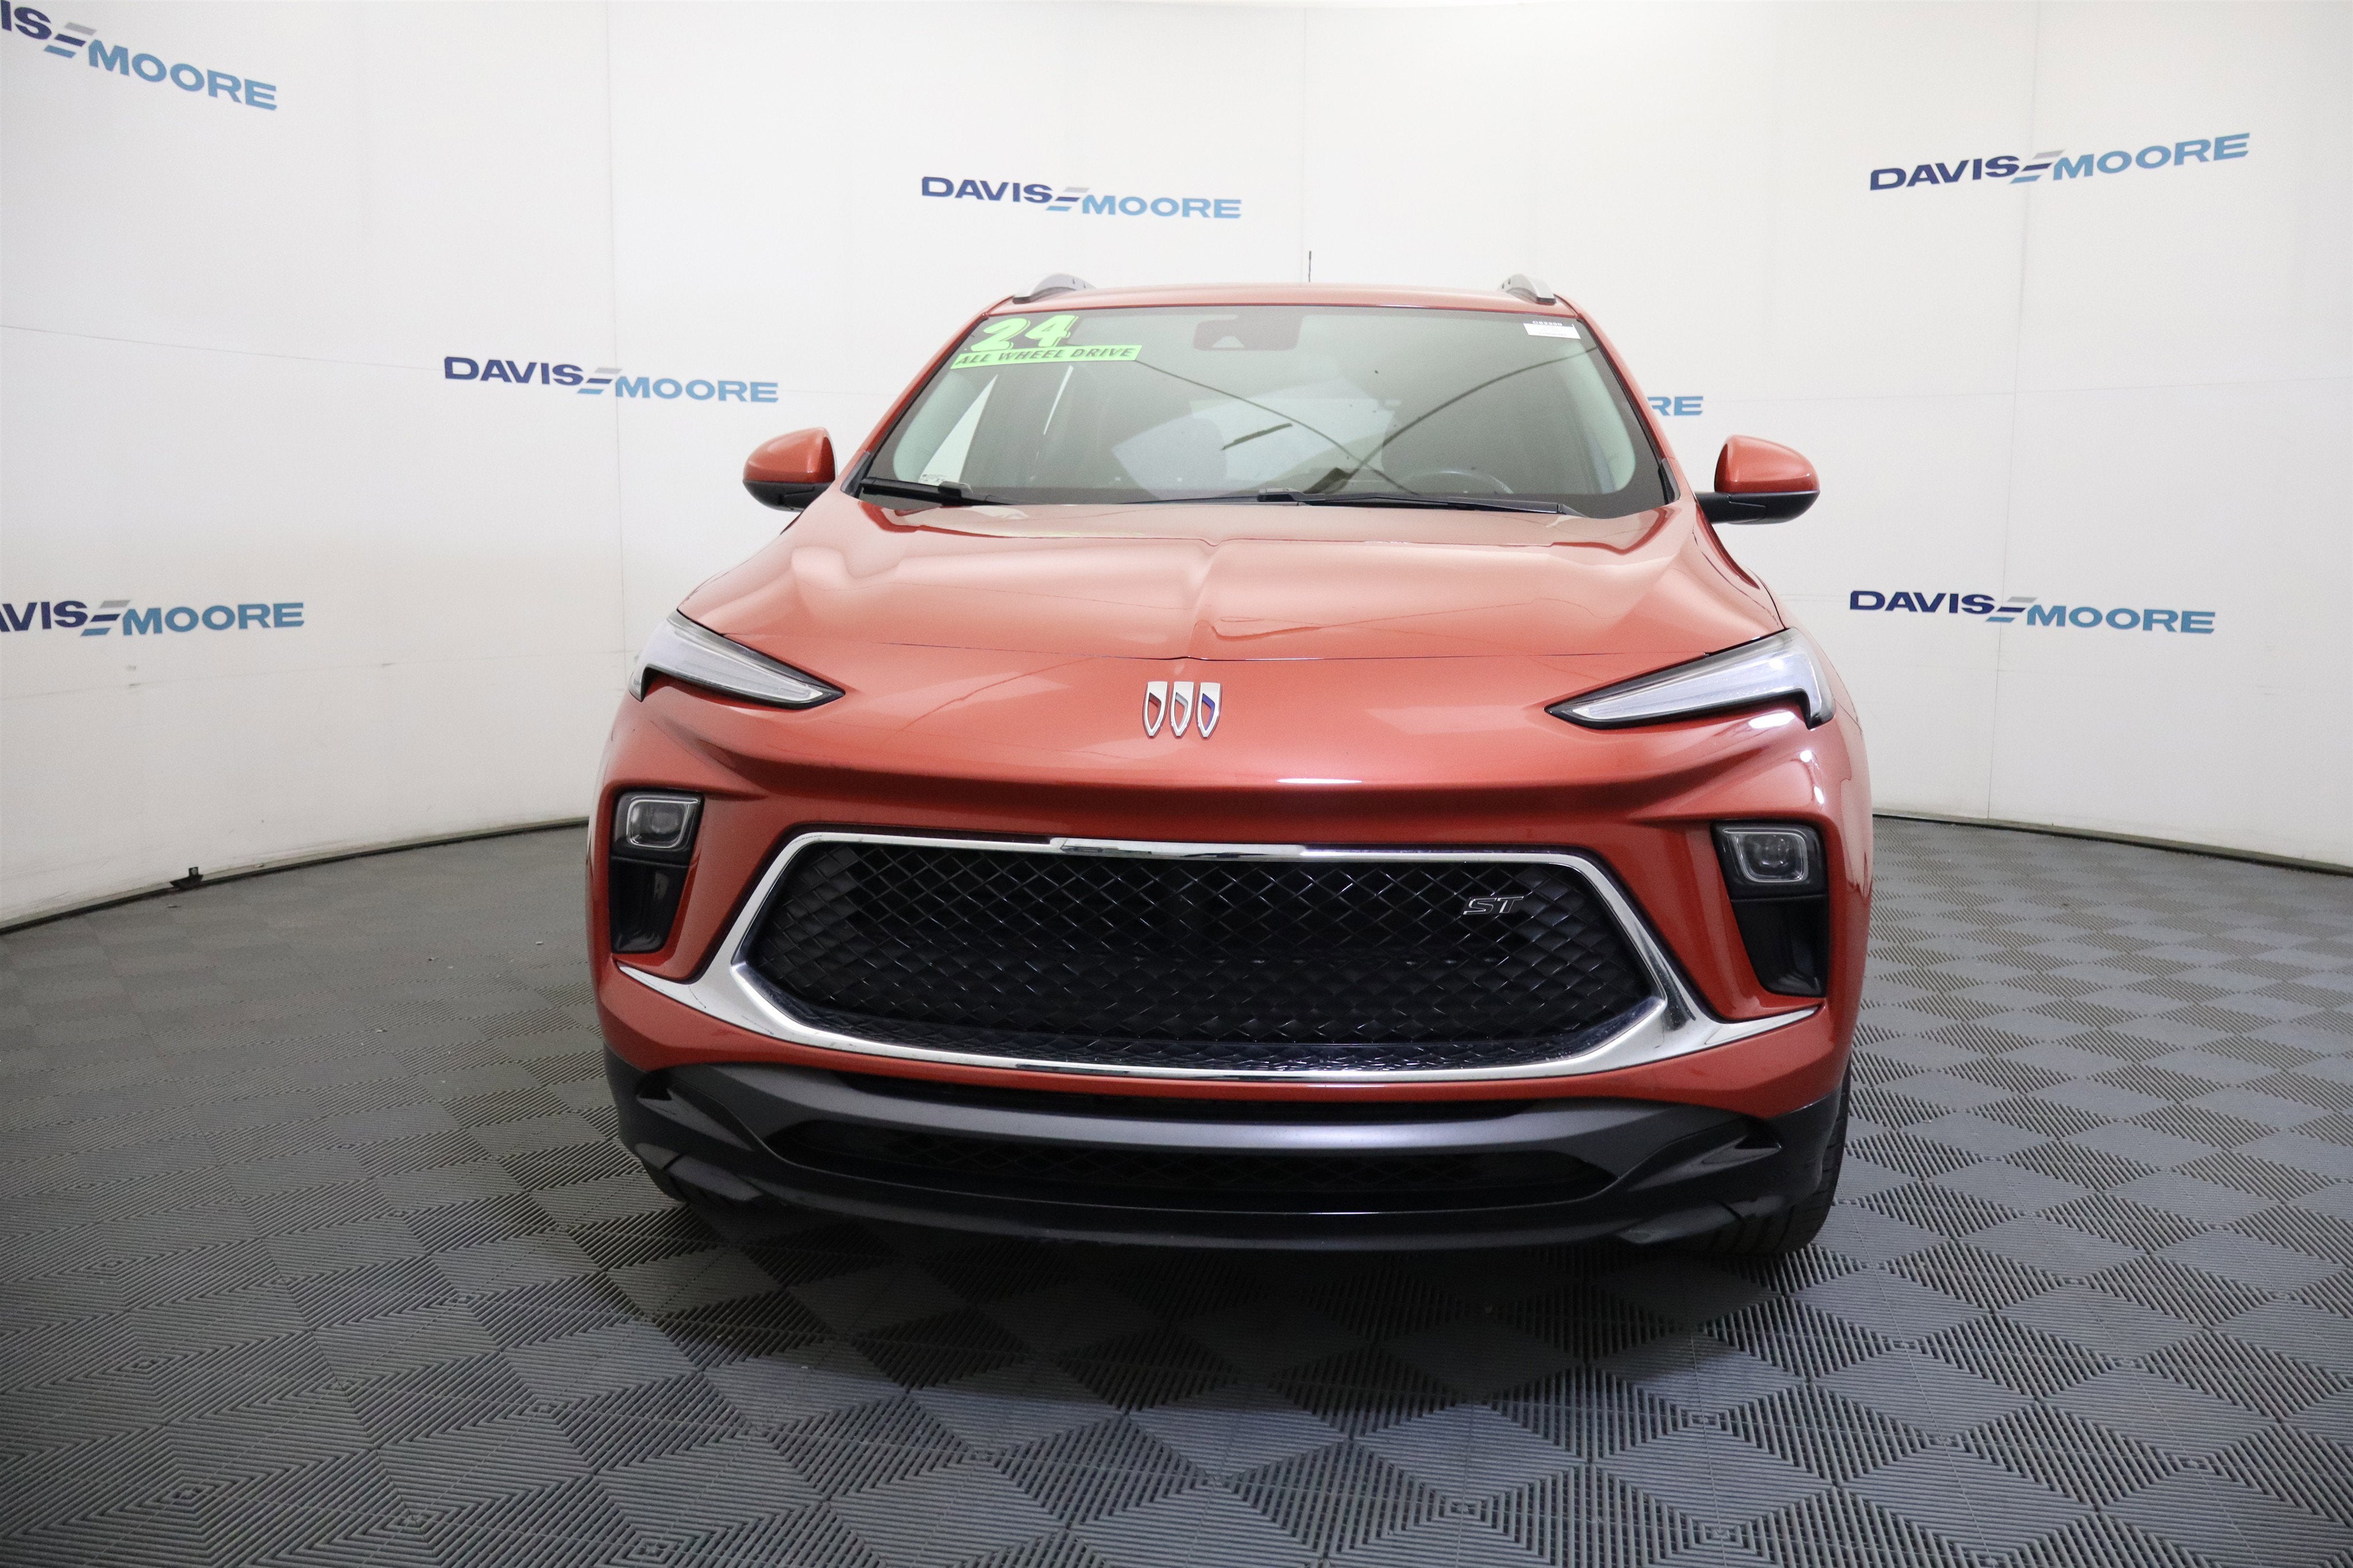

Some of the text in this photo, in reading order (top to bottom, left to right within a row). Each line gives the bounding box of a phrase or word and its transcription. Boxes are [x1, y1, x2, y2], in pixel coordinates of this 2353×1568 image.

[88, 39, 277, 111] MOORE
[1870, 133, 2250, 191] DAVIS MOORE
[921, 176, 1242, 219] DAVIS MOORE
[971, 315, 1078, 352] 24
[954, 348, 1135, 365] ALL WHEEL DRIVE
[444, 357, 779, 403] DAVIS MOORE
[122, 602, 304, 636] MOORE
[1849, 590, 2216, 634] DAVIS MOORE
[1463, 896, 1524, 915] ST
